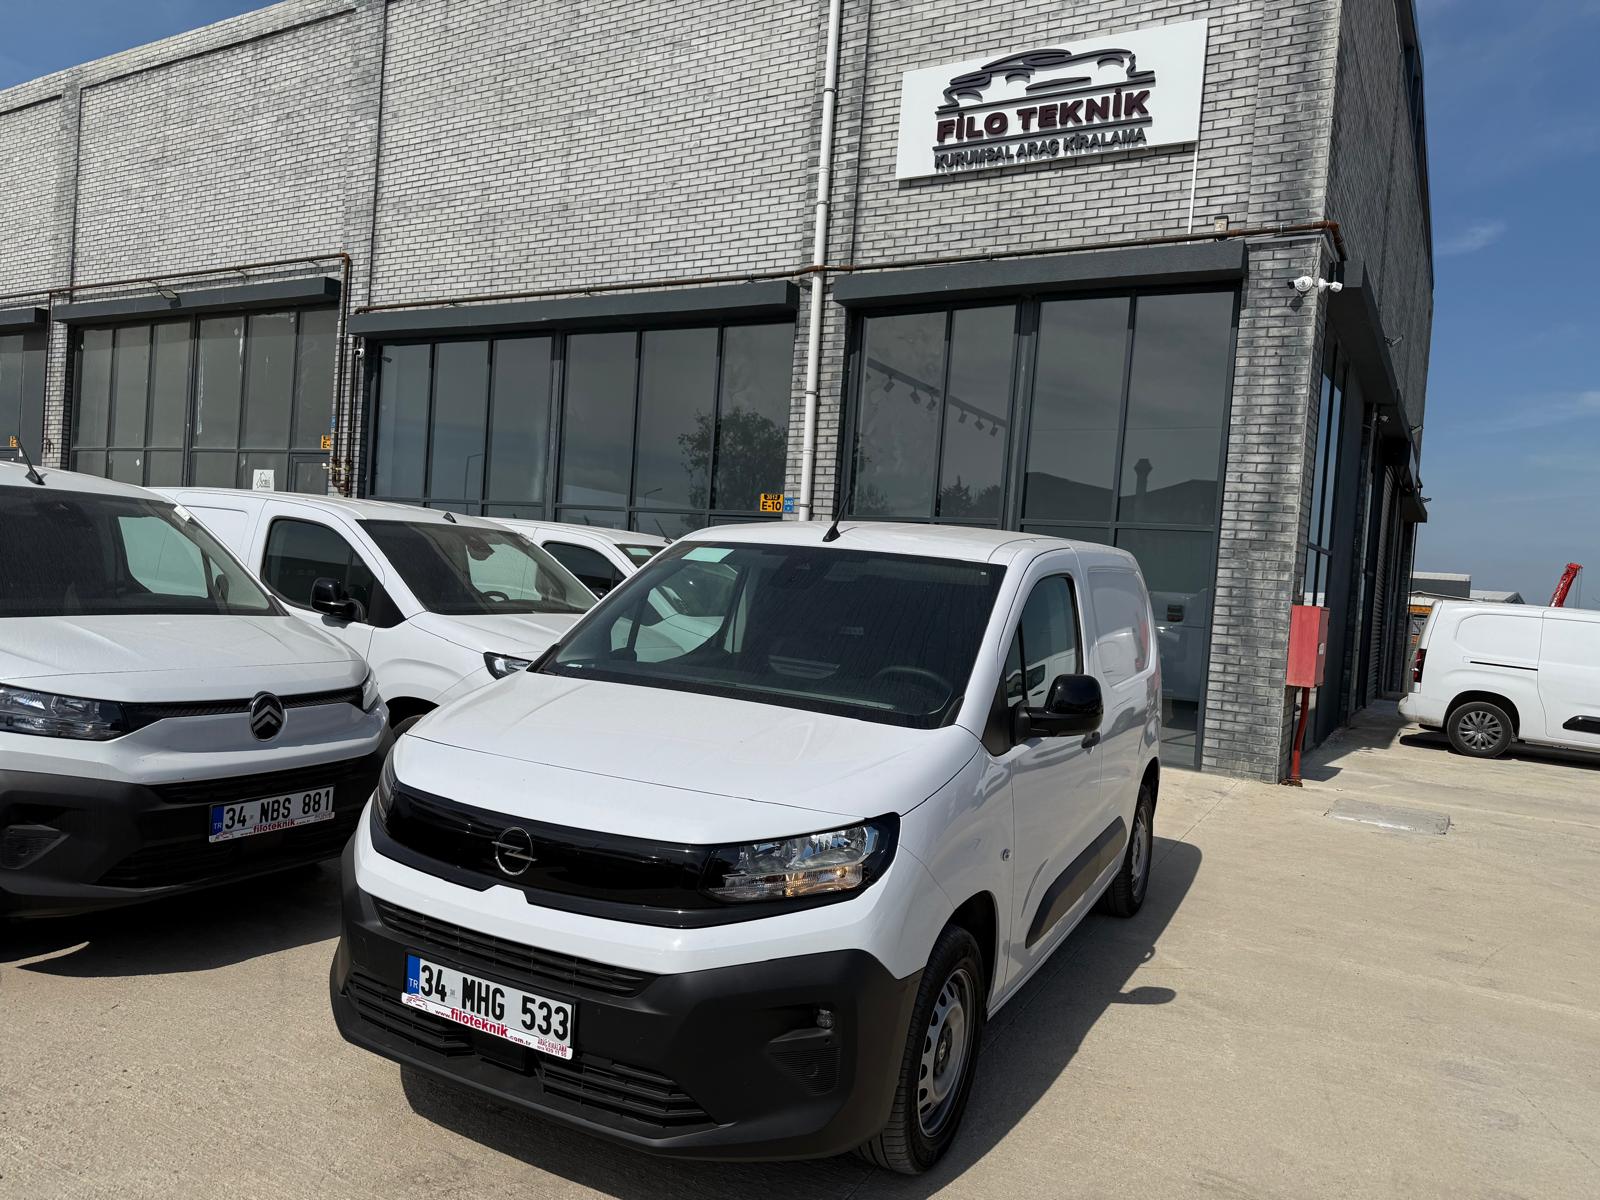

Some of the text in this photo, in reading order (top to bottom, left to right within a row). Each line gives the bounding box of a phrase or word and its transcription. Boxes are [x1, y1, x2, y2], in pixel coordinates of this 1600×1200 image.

[936, 88, 1151, 143] FİLO TEKNİK
[934, 127, 1147, 169] KURUMSAL ARAÇ KİRALAMA
[761, 501, 782, 511] E-10
[225, 806, 247, 829] 34
[259, 797, 292, 824] NBS
[302, 789, 330, 815] 881
[408, 965, 569, 1041] TR 34 MHG 533
